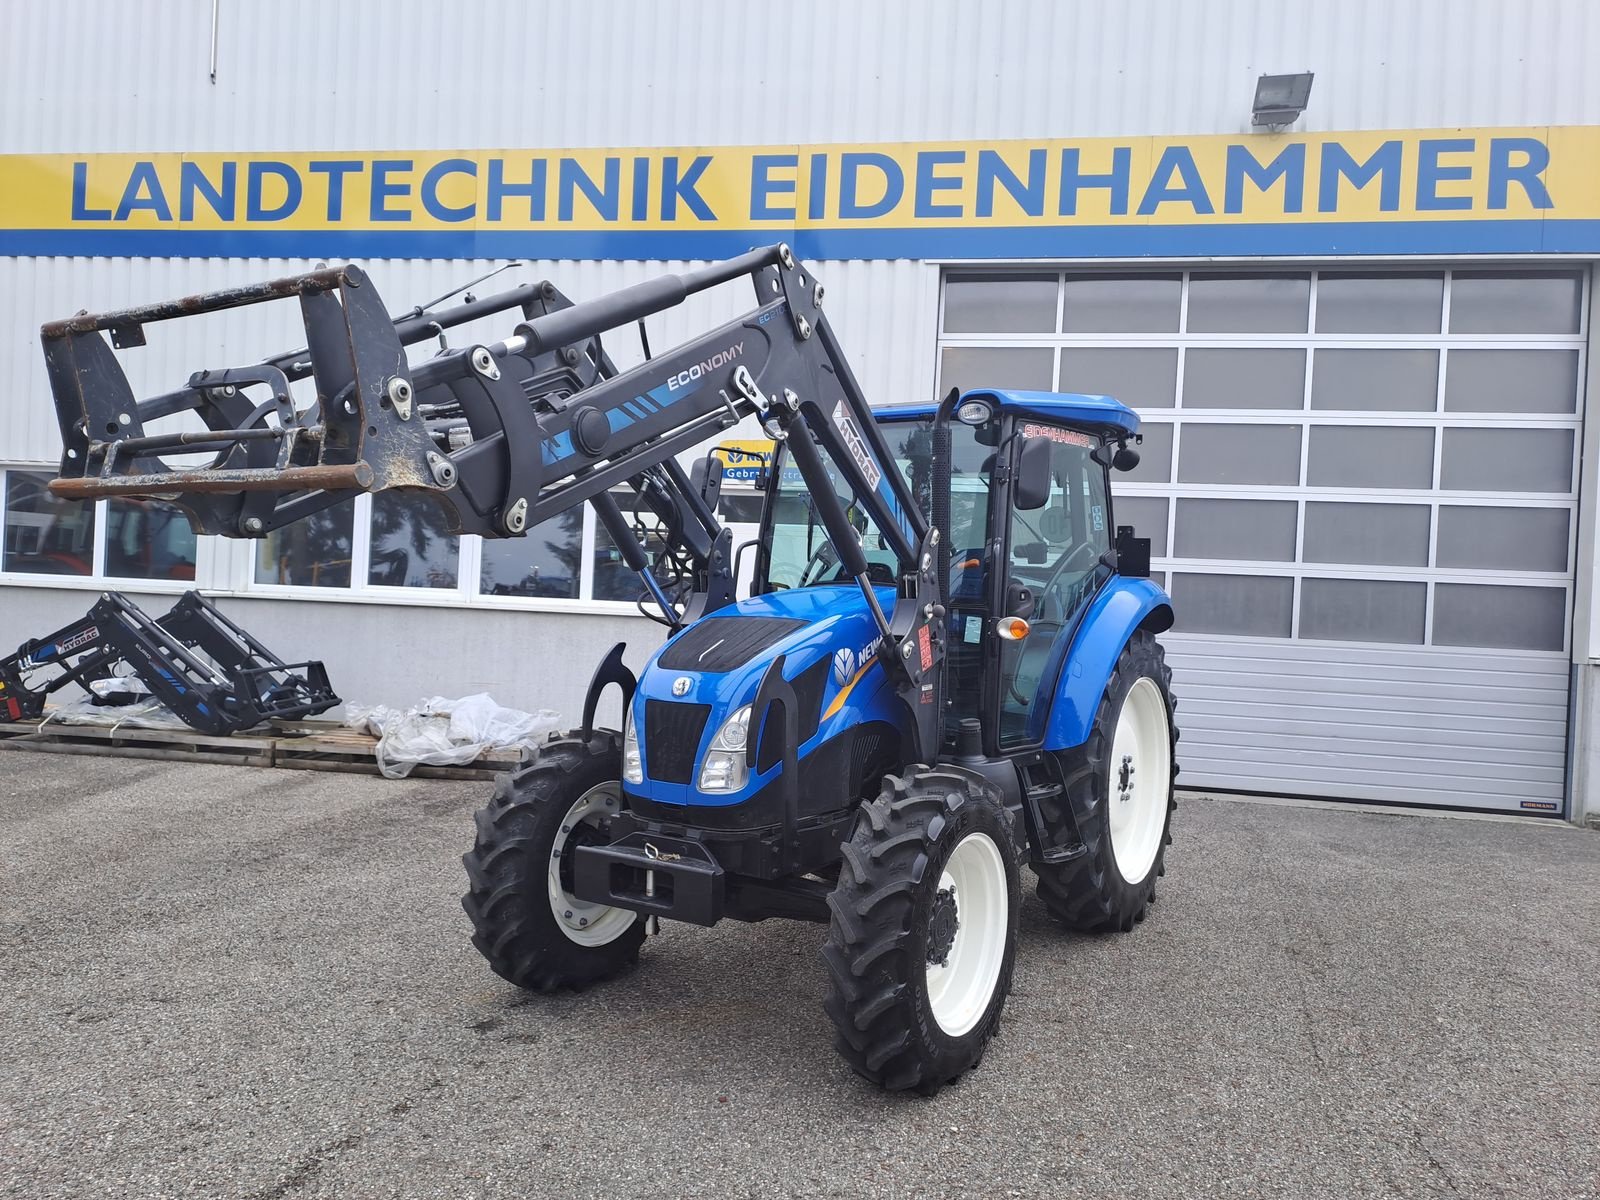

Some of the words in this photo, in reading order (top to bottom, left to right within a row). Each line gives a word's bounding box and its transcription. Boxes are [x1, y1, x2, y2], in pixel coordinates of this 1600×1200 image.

[71, 155, 717, 223] LANDTECHNIK
[749, 137, 1554, 220] EIDENHAMMER
[667, 341, 744, 392] ECONOMY
[840, 420, 876, 487] HYDRAC
[64, 631, 97, 651] HYDRAC
